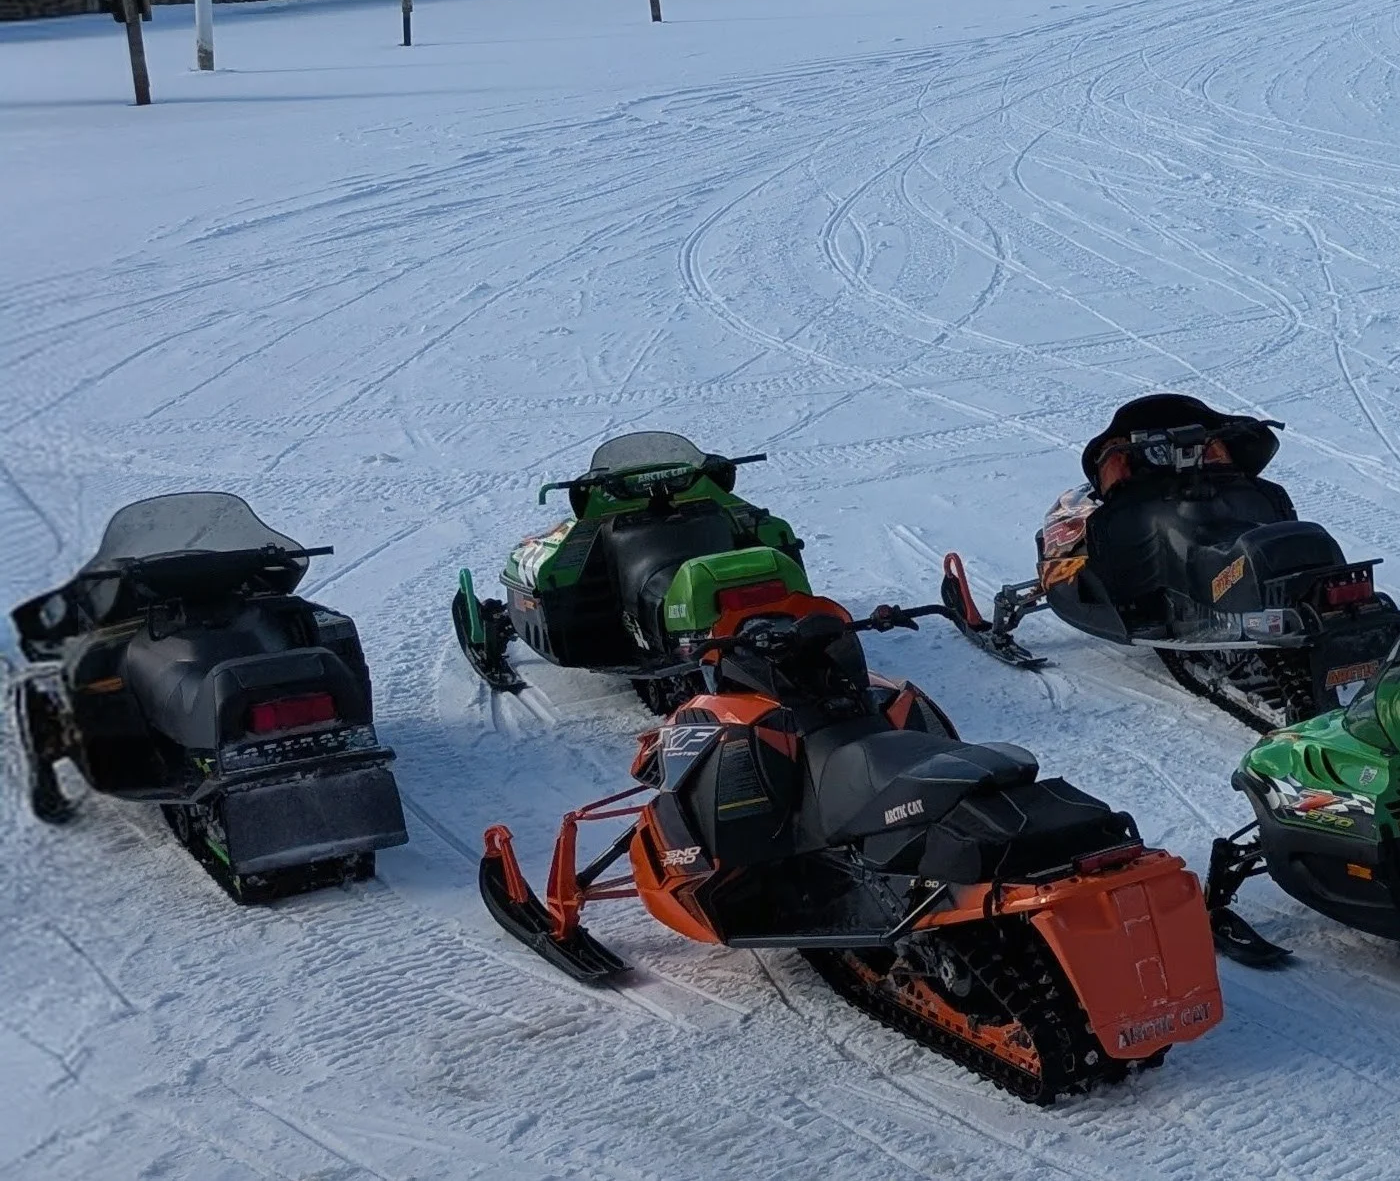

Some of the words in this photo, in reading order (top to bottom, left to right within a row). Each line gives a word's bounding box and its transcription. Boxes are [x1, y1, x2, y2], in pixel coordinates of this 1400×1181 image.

[638, 469, 670, 483] ARCTIC
[885, 804, 907, 825] ARCTIC
[907, 799, 924, 816] CAT
[1305, 810, 1354, 828] 570
[665, 846, 701, 857] SNO
[663, 855, 696, 867] PRO
[1118, 1014, 1176, 1049] ARCTIC
[1181, 1003, 1211, 1026] CAT
